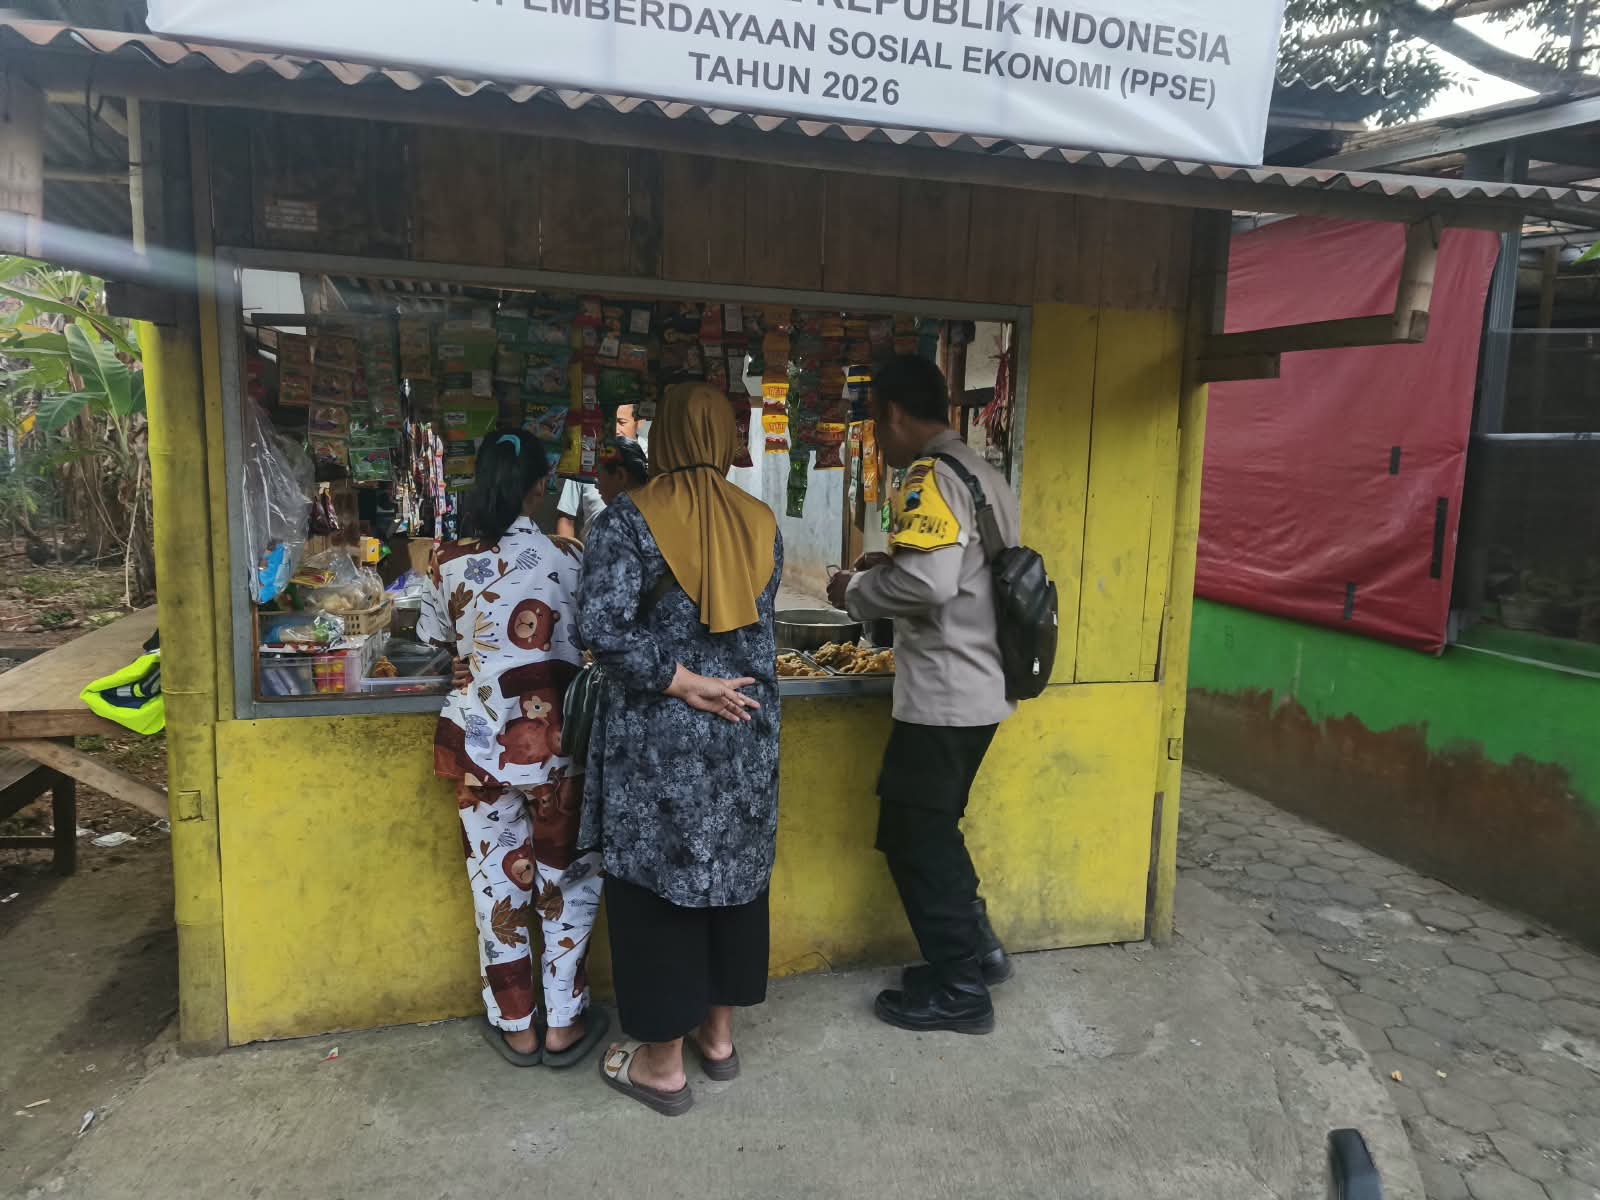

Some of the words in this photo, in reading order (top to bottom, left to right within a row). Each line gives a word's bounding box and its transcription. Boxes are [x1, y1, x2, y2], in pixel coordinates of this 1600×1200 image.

[496, 0, 816, 52] MBERDAYAAN
[827, 26, 952, 70] SOSIAL
[962, 45, 1111, 91] EKONOMI
[1120, 66, 1216, 110] (PPSE)
[817, 0, 1022, 35] UBLIK
[1034, 6, 1231, 65] INDONESIA
[688, 51, 810, 95] TAHUN
[822, 70, 900, 106] 2026
